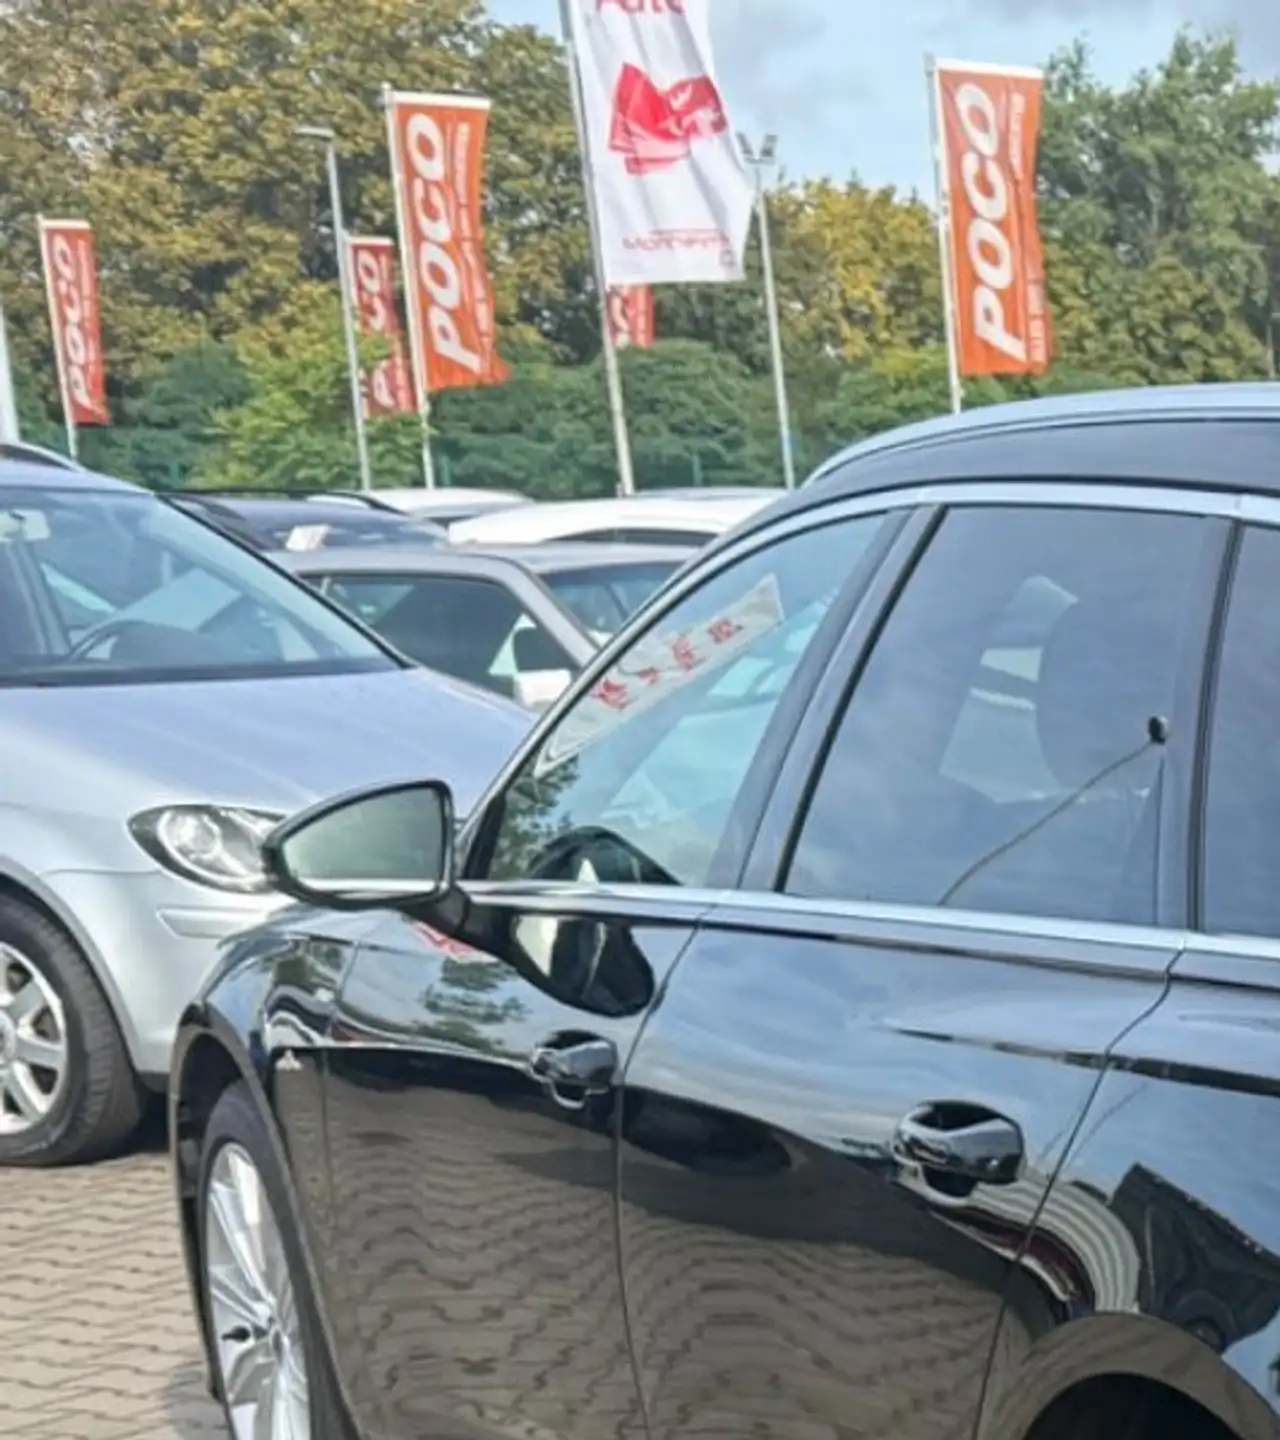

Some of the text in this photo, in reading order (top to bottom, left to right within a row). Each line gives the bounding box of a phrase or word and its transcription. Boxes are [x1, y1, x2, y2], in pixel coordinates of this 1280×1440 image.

[52, 234, 96, 411] POCO
[406, 113, 482, 375] POCO
[955, 83, 1028, 363] POCO
